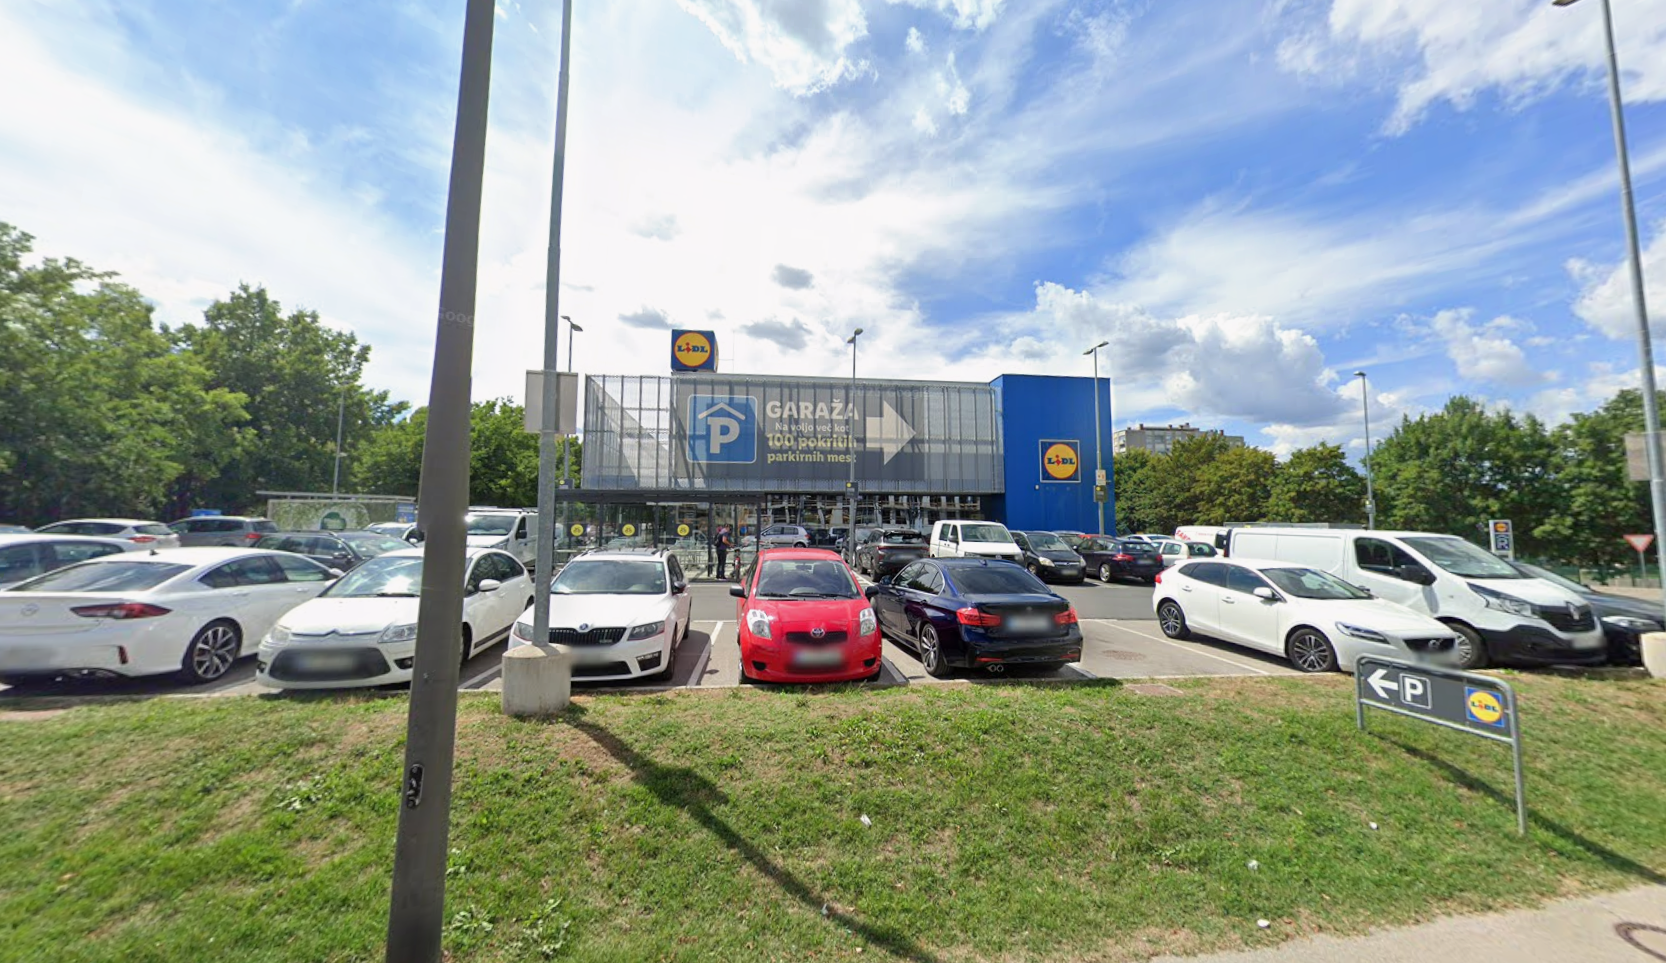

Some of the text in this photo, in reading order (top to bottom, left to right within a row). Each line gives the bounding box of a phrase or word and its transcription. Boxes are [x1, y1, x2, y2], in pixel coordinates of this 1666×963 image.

[766, 399, 859, 420] GARAŽA
[706, 417, 740, 454] P
[775, 422, 850, 433] Na voljo več kot
[767, 433, 794, 447] 100
[767, 451, 824, 464] parkirnih
[1404, 678, 1424, 702] P
